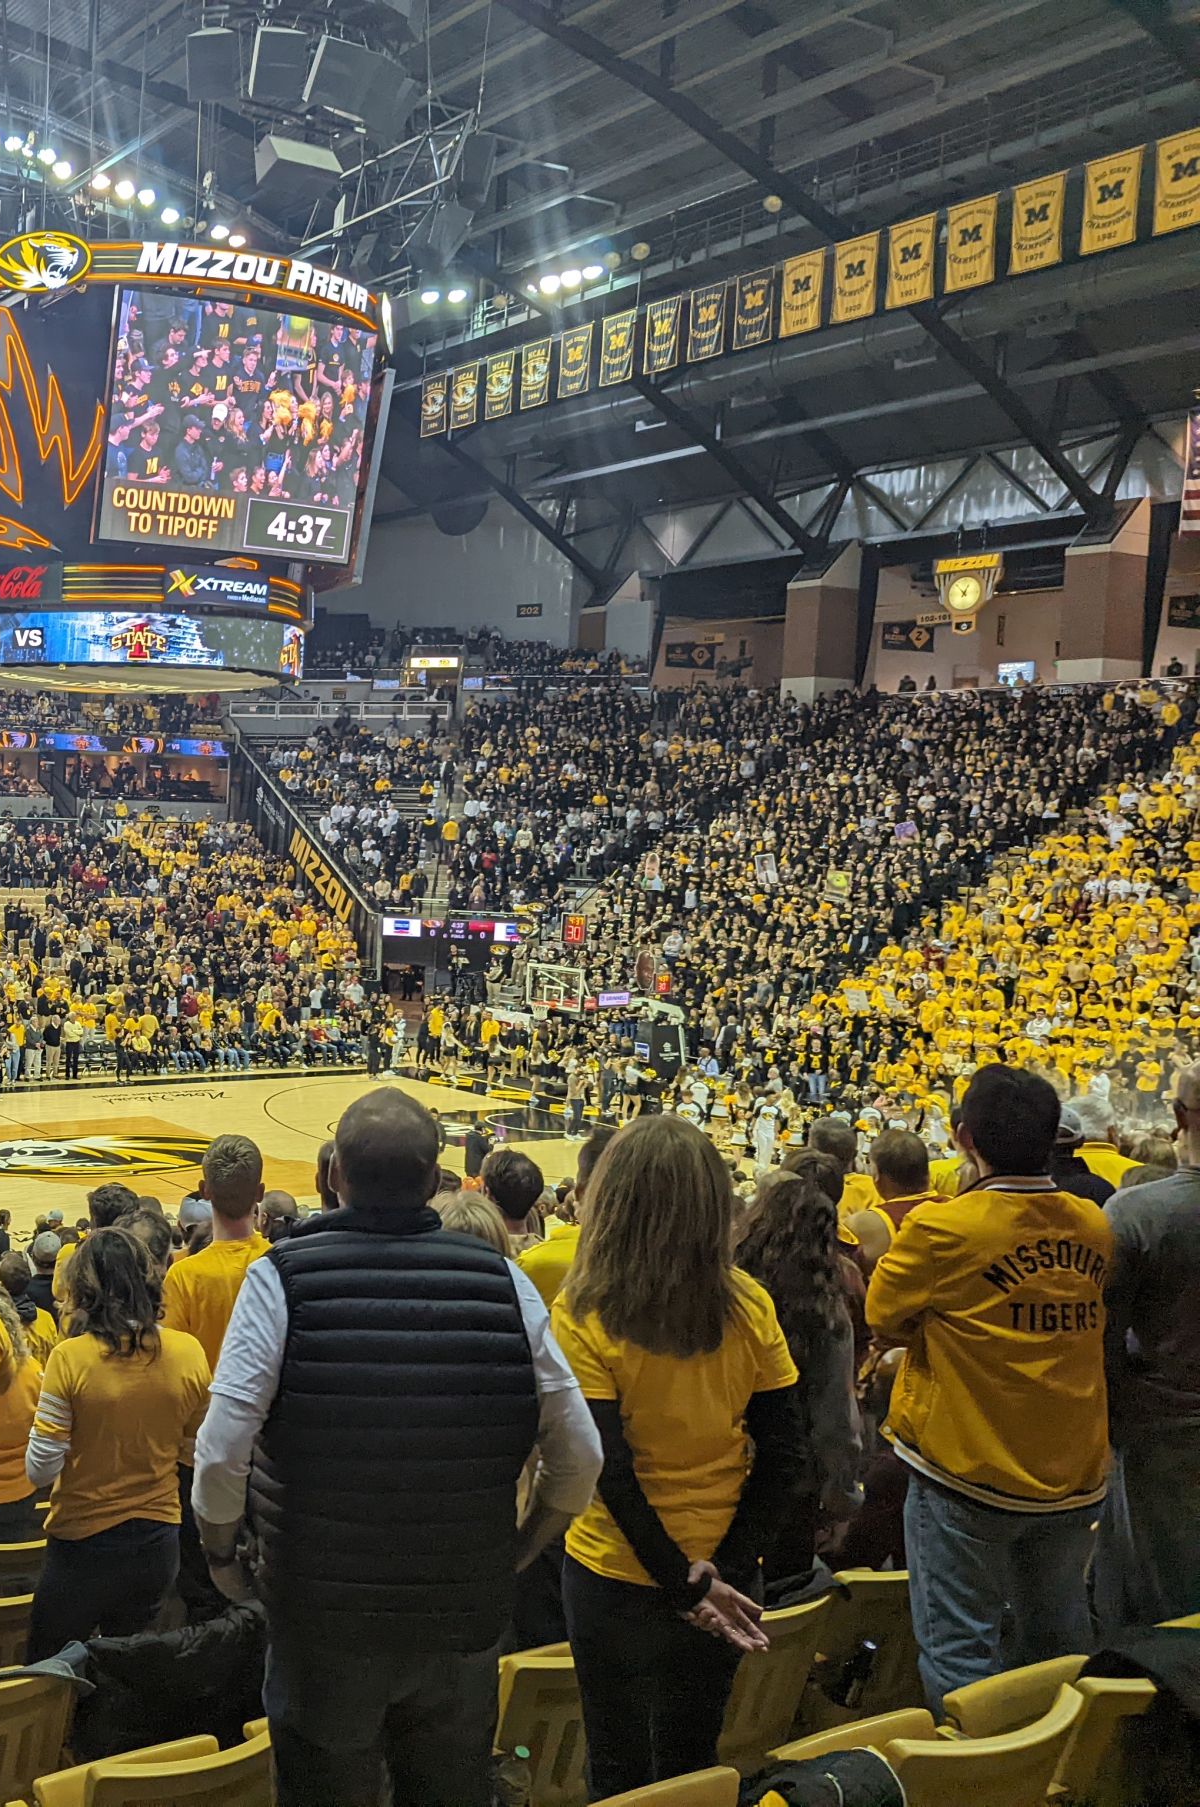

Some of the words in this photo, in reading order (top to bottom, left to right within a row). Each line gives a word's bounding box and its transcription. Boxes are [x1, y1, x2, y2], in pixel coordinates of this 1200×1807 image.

[1097, 179, 1125, 204] M
[1024, 203, 1050, 227] M
[958, 223, 983, 247] M
[899, 241, 923, 264] M
[137, 242, 281, 286] MIZZOU
[286, 260, 369, 313] ARENA
[844, 259, 866, 280] M
[791, 275, 812, 296] M
[745, 289, 766, 310] M
[698, 304, 718, 324] M
[654, 318, 671, 337] M
[609, 331, 627, 350] M
[567, 346, 583, 363] M
[112, 487, 236, 519] COUNTDOWN
[127, 511, 152, 534] TO
[156, 514, 218, 540] TIPOFF
[266, 511, 332, 546] 4:37
[195, 577, 268, 596] XTREAM
[15, 629, 43, 647] VS
[111, 630, 167, 652] STATE
[289, 827, 354, 924] MIZZOU
[567, 927, 580, 941] 30
[1008, 1301, 1098, 1332] TIGERS
